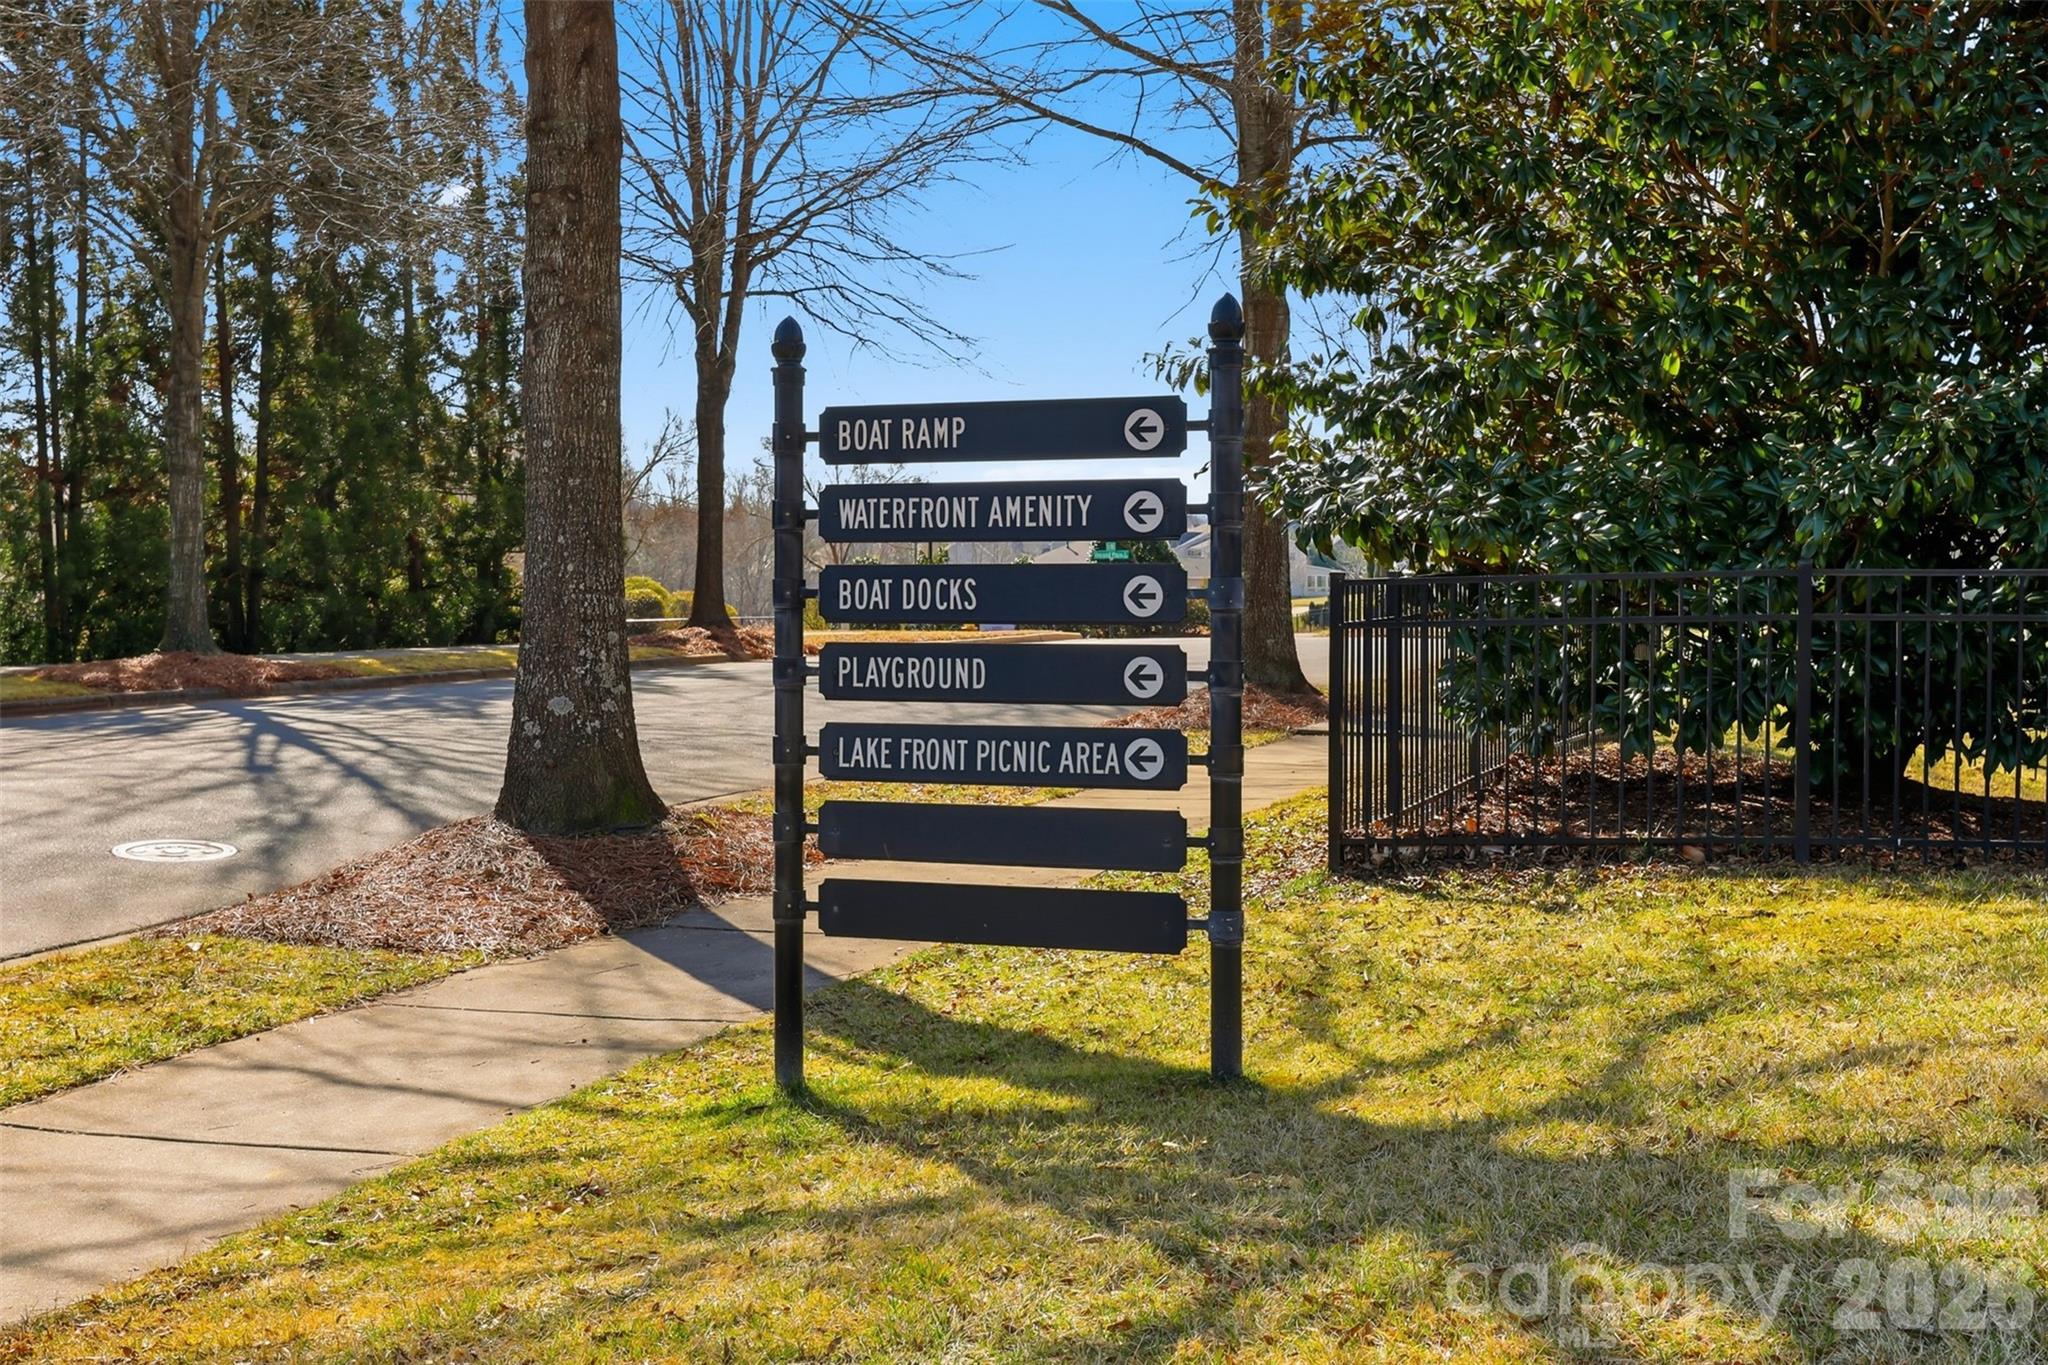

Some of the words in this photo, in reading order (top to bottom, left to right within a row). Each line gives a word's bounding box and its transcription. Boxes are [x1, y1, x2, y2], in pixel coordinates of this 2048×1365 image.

[838, 419, 892, 451] BOAT
[902, 416, 966, 449] RAMP
[839, 496, 980, 530] WATERFRONT
[988, 494, 1092, 528] AMENITY
[839, 578, 892, 610] BOAT
[902, 578, 977, 610] DOCKS
[838, 656, 986, 689] PLAYGROUND
[838, 736, 892, 769] LAKE
[900, 738, 968, 771] FRONT
[976, 739, 1050, 773] PICNIC
[1058, 741, 1120, 775] AREA
